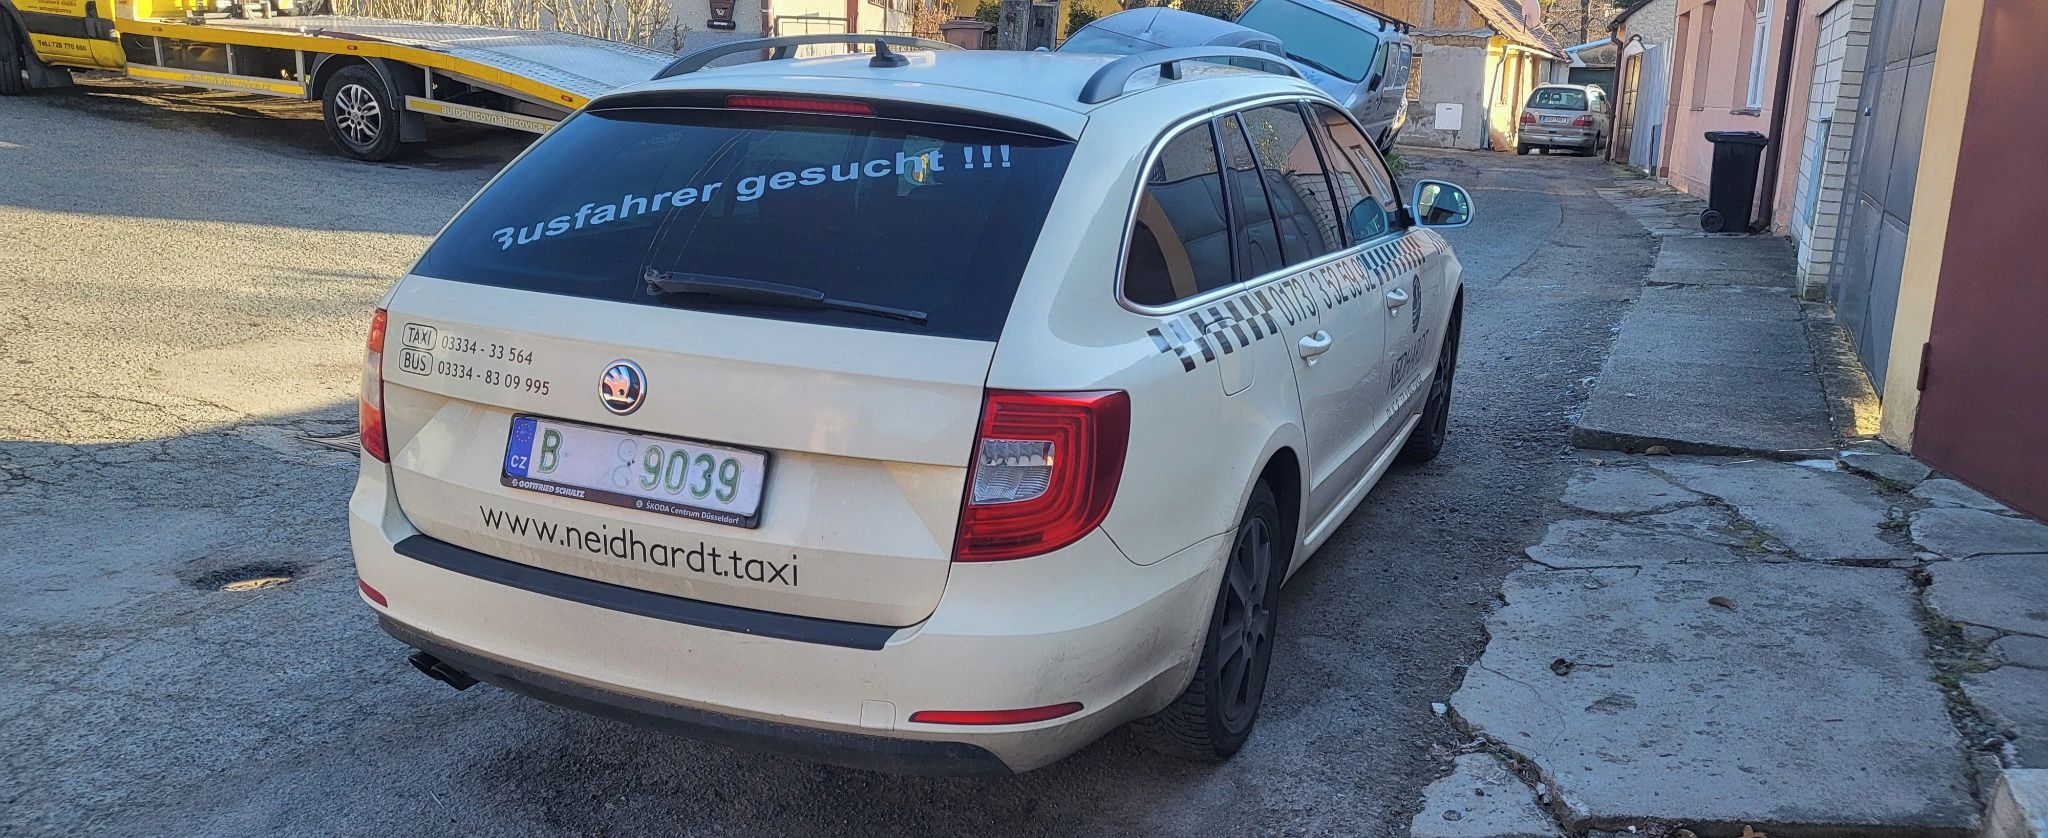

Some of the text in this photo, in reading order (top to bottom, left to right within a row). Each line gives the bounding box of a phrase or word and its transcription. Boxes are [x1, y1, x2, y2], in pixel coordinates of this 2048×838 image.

[736, 147, 945, 201] gesucht
[963, 144, 1011, 169] !!!
[408, 327, 432, 347] TAXI
[441, 335, 477, 355] 03334
[489, 343, 505, 360] 33
[508, 347, 533, 365] 564
[404, 352, 427, 372] BUS
[438, 360, 473, 381] 03334
[485, 370, 500, 386] 83
[504, 374, 521, 390] 09
[525, 378, 550, 396] 995
[510, 454, 527, 470] CZ
[638, 444, 742, 504] 9039
[518, 479, 586, 498] GOTTFRIED SCHULTZ
[645, 498, 741, 526] ŠKODA Centrum Düsseldorf
[480, 504, 800, 587] www.neidhardt.taxi
